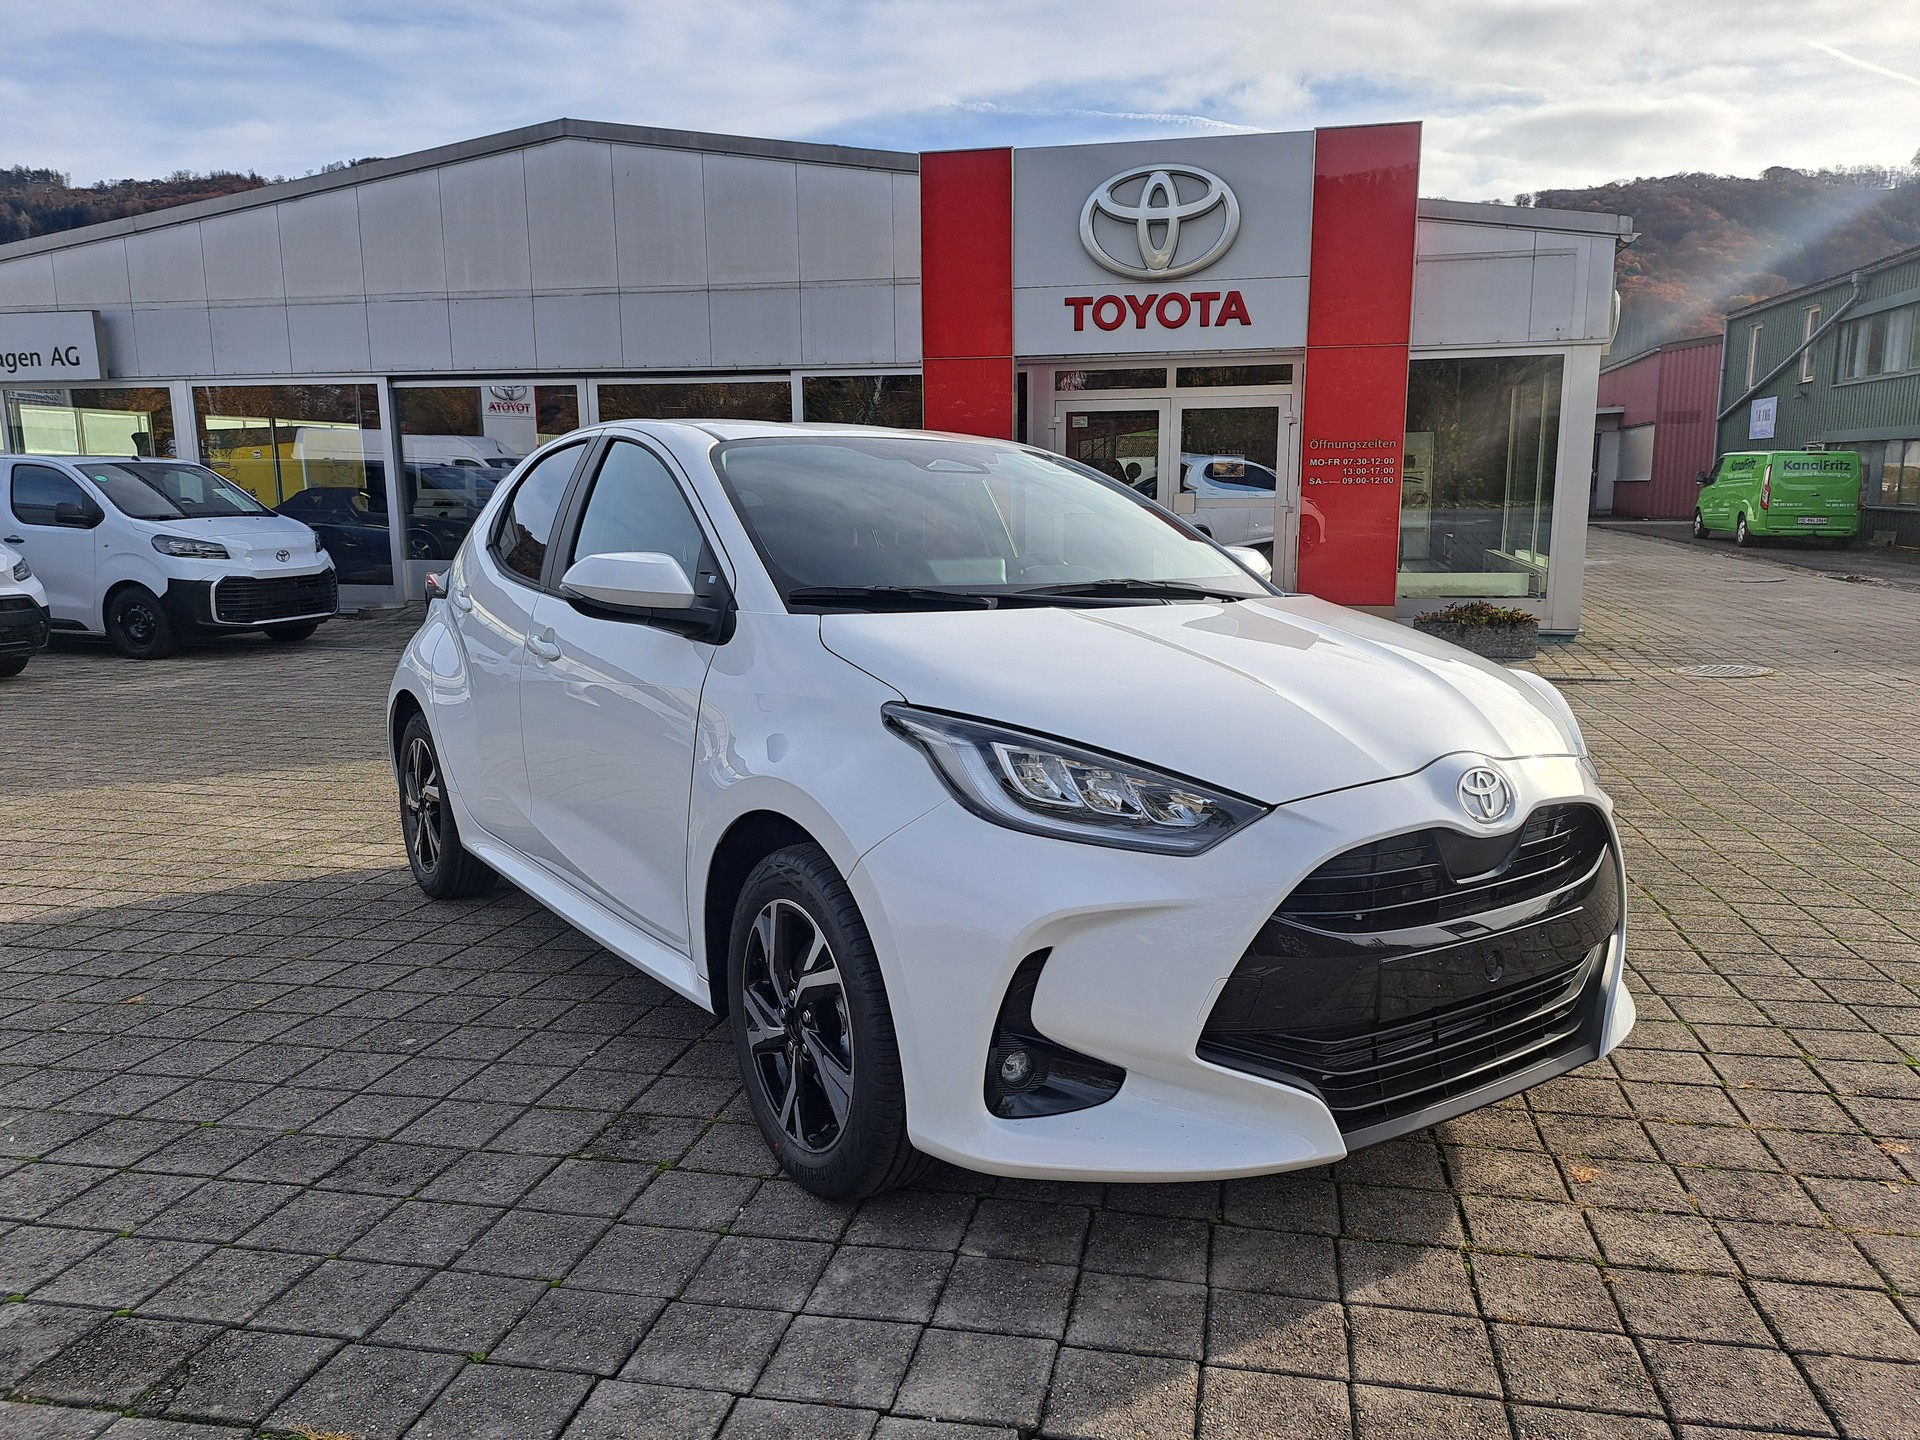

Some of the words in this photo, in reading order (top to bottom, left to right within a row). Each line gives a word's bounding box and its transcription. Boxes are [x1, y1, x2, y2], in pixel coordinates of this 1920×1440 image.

[1064, 291, 1252, 331] TOYOTA
[51, 346, 80, 366] AG
[1310, 438, 1396, 451] Öffnungszeiten
[1309, 458, 1341, 466] MO-FR
[1342, 457, 1395, 465] 07:30-12:00
[1784, 459, 1851, 470] KanalFritz
[1343, 467, 1394, 475] 13:00-17:00
[1309, 477, 1322, 485] SA
[1342, 476, 1394, 485] 09:00-12:00
